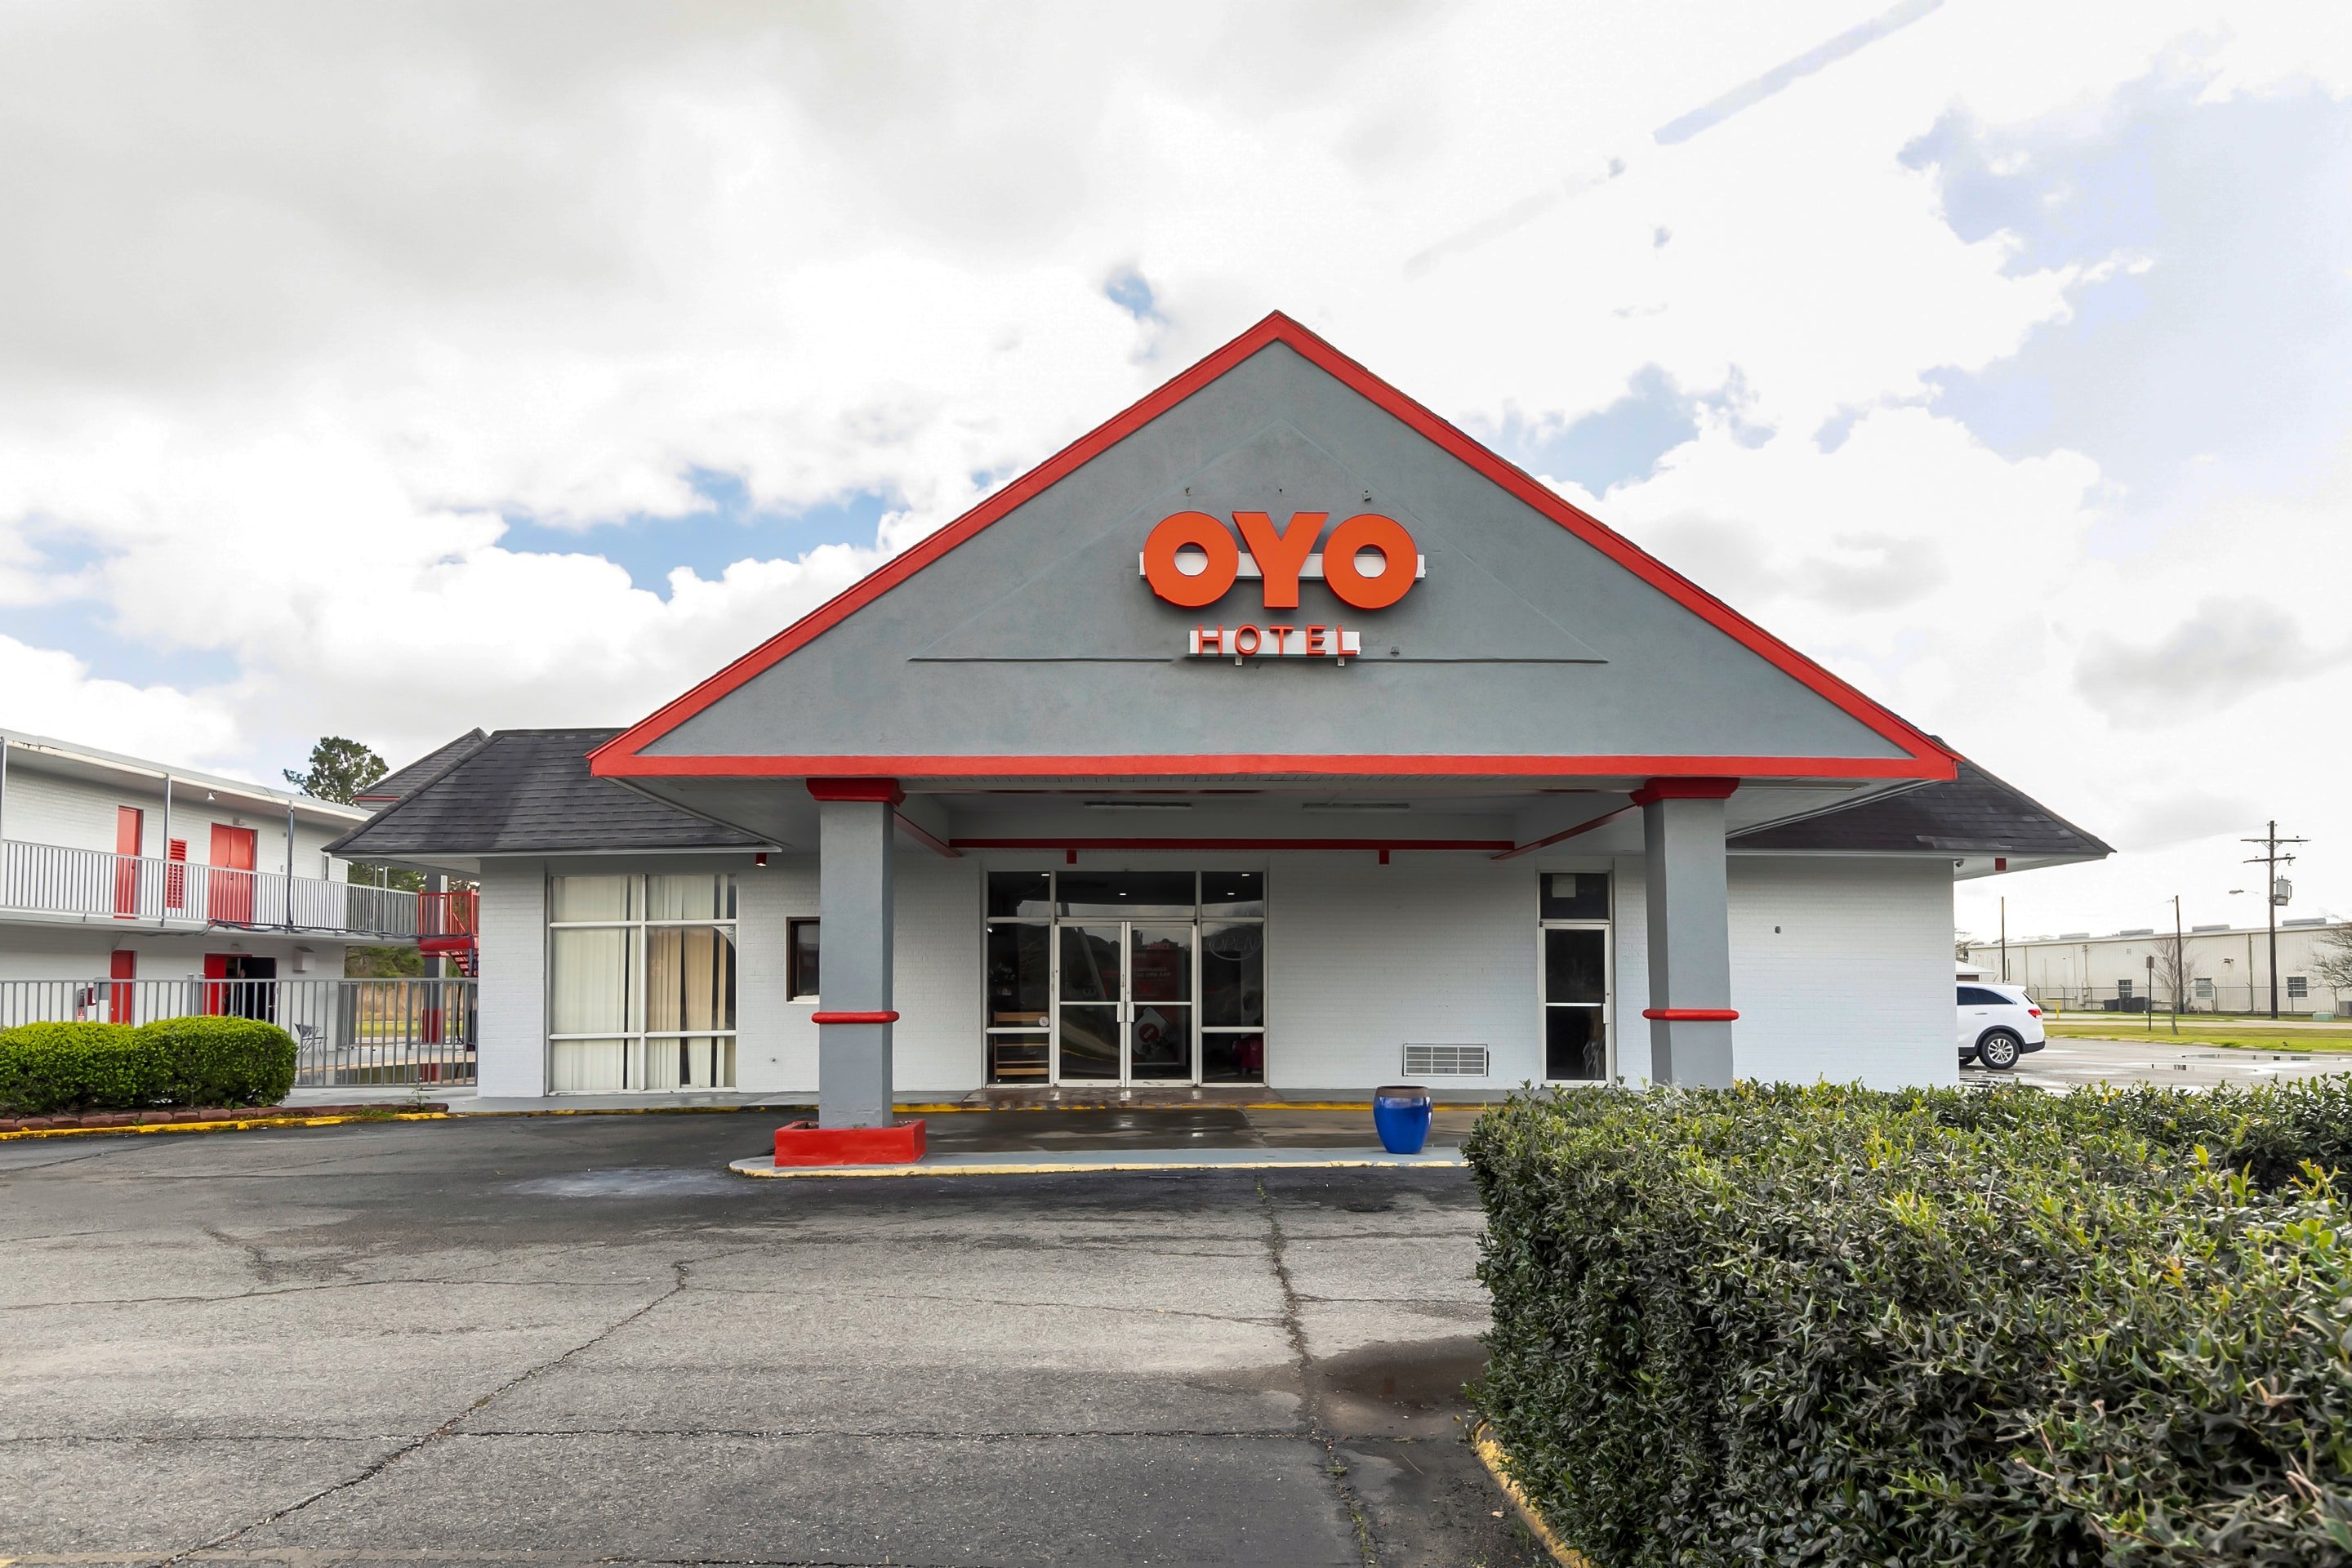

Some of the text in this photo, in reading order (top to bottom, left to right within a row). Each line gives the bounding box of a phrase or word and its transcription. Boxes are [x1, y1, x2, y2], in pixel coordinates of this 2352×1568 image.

[1143, 510, 1419, 610] OYO
[1196, 624, 1359, 657] HOTEL
[1213, 935, 1256, 951] OPEN
